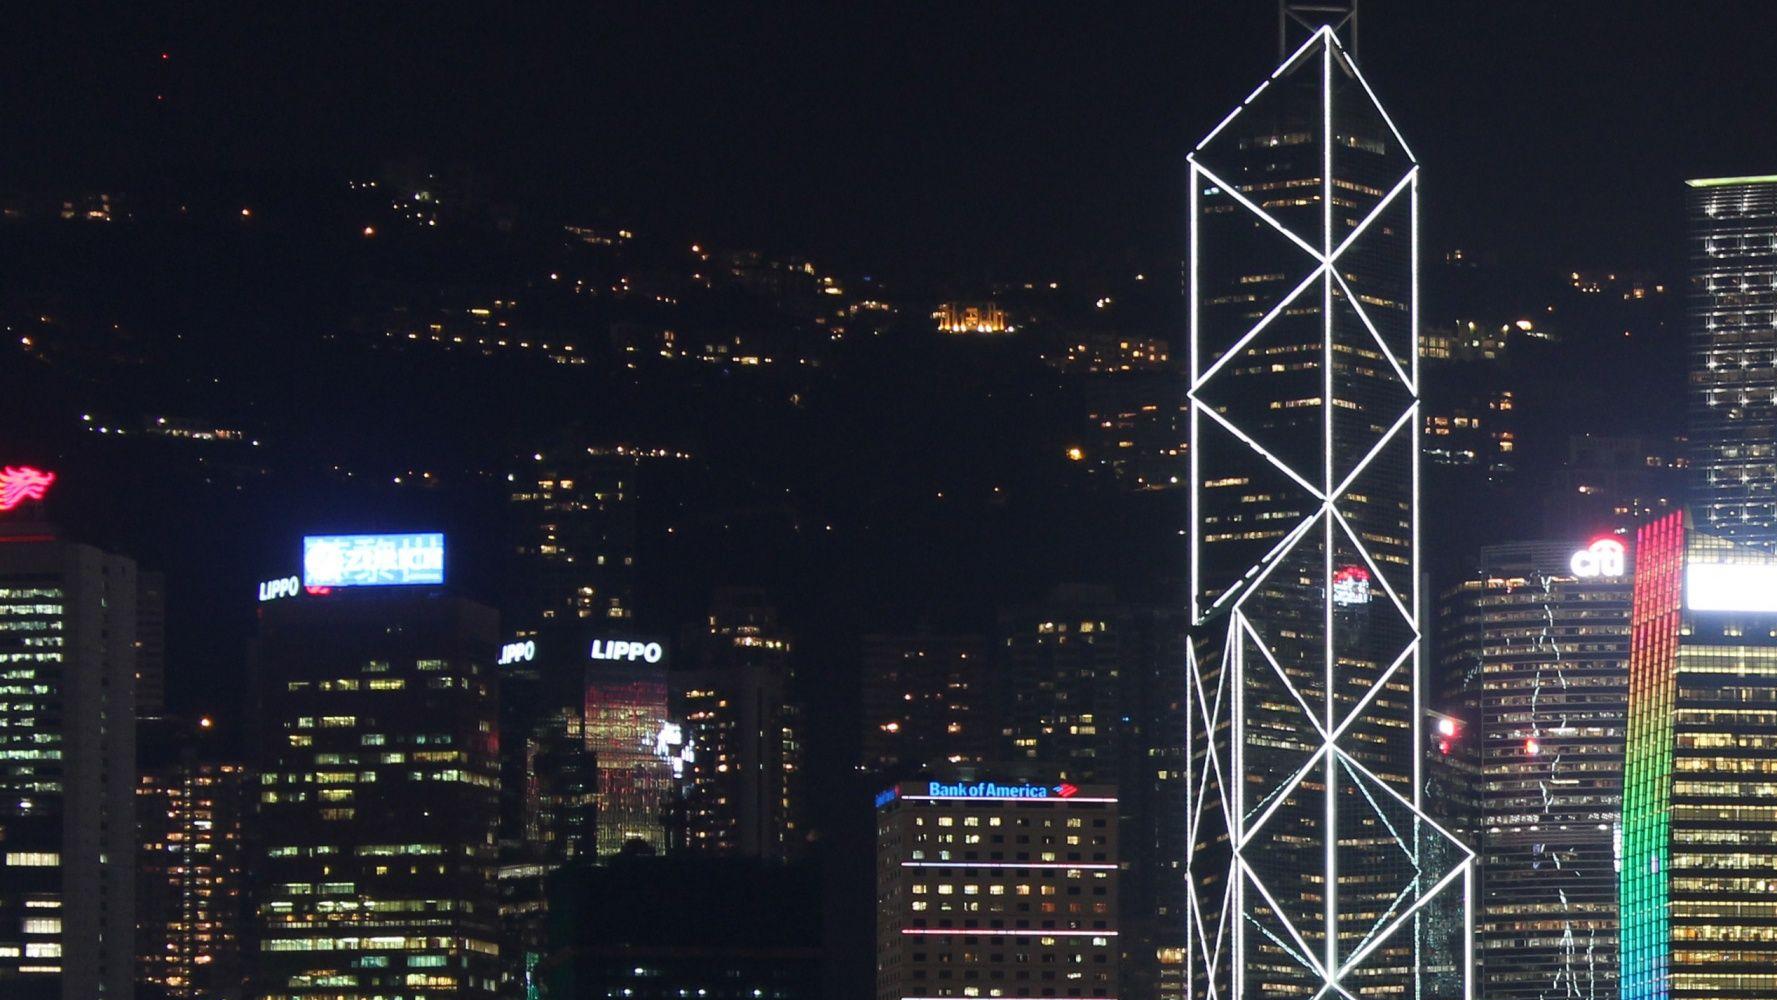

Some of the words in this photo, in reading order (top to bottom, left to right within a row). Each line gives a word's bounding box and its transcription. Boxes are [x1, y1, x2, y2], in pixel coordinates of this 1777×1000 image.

[259, 576, 299, 601] LIPPO
[591, 639, 662, 663] LIPPO
[929, 782, 967, 798] Bank
[969, 782, 985, 798] of
[986, 783, 1047, 798] America
